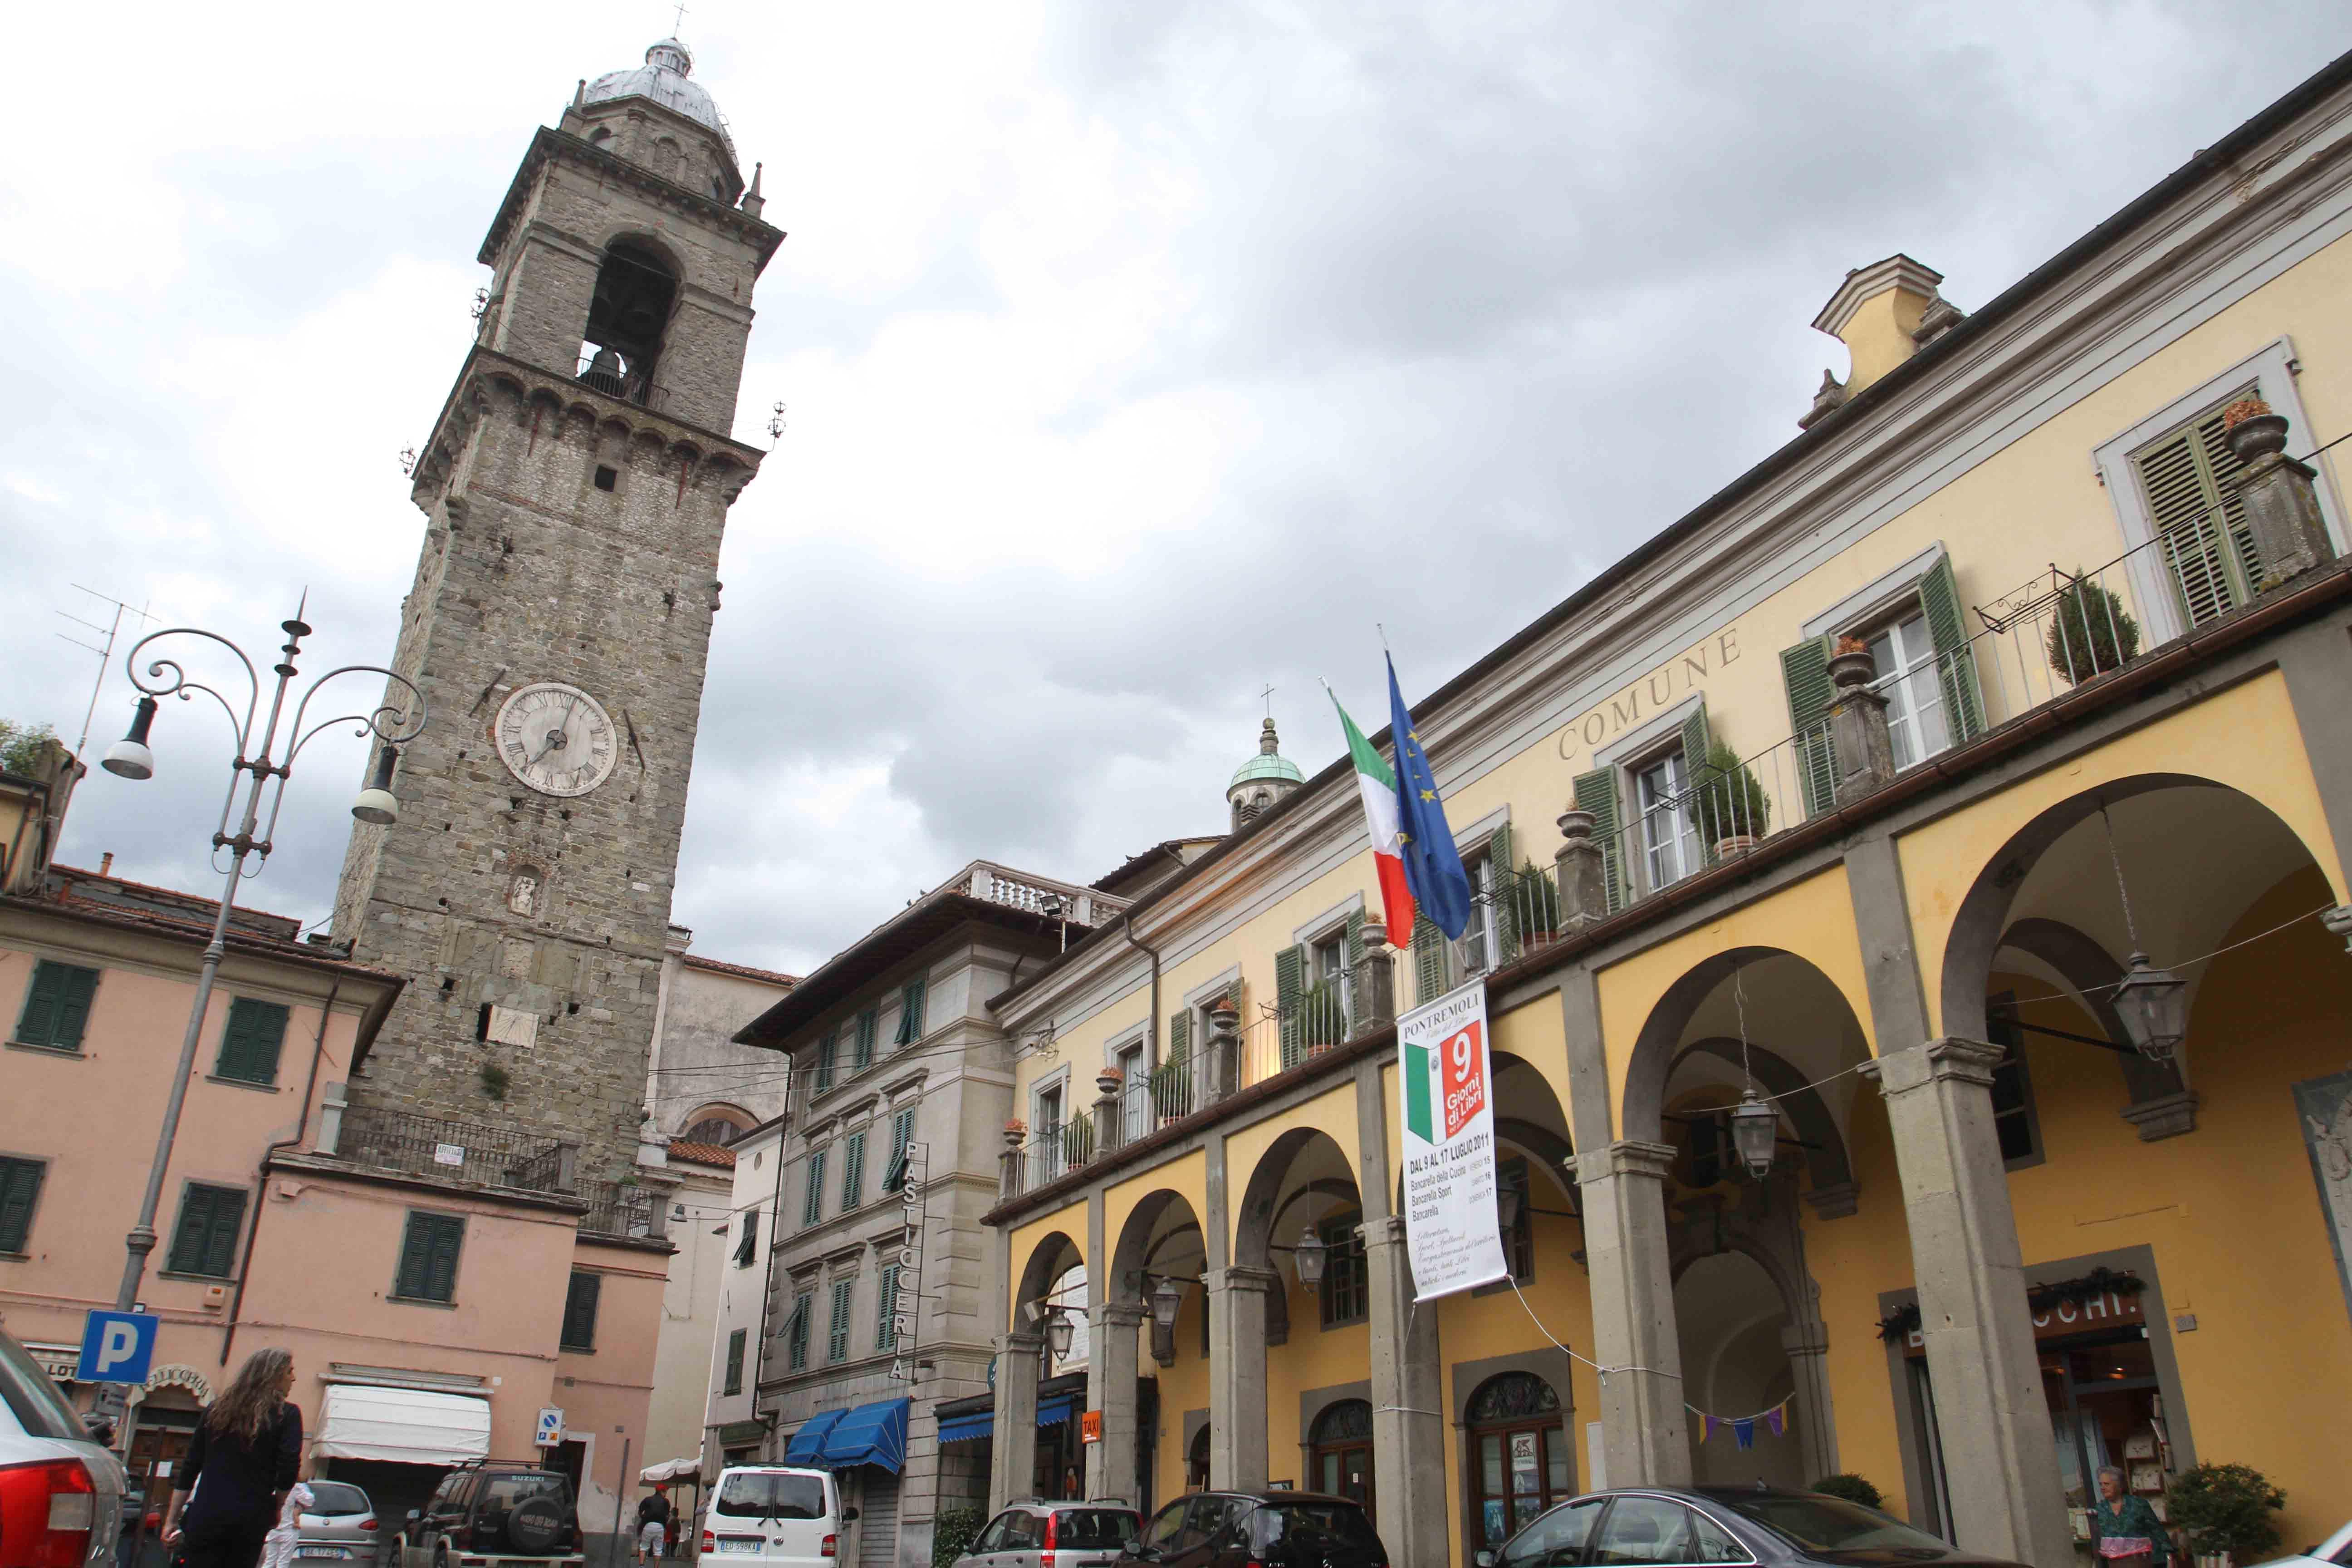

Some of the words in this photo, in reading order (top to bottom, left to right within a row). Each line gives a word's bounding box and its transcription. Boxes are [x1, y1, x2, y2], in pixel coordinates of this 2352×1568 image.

[1558, 627, 1741, 761] COMUNE
[1405, 993, 1478, 1039] PONTREMOLI
[1453, 1032, 1471, 1083] 9
[1447, 1072, 1480, 1110] Giorni
[1448, 1107, 1459, 1126] di
[1460, 1086, 1482, 1117] Libri
[1410, 1158, 1423, 1175] DAL
[1424, 1156, 1428, 1169] 9
[1430, 1152, 1439, 1167] AL
[1441, 1148, 1448, 1163] 17
[1450, 1139, 1473, 1161] LUGLIO
[1474, 1132, 1489, 1151] 2011
[1484, 1155, 1490, 1165] 15
[1411, 1175, 1436, 1192] Bancarella
[1412, 1189, 1437, 1207] Bancarella
[1438, 1185, 1452, 1200] Sport
[1485, 1187, 1491, 1197] 17
[1413, 1205, 1439, 1222] Bancarella
[889, 1142, 919, 1379] PASTICCERIA
[96, 1321, 138, 1372] P
[1083, 1419, 1099, 1434] TAXI
[725, 1542, 734, 1550] ED
